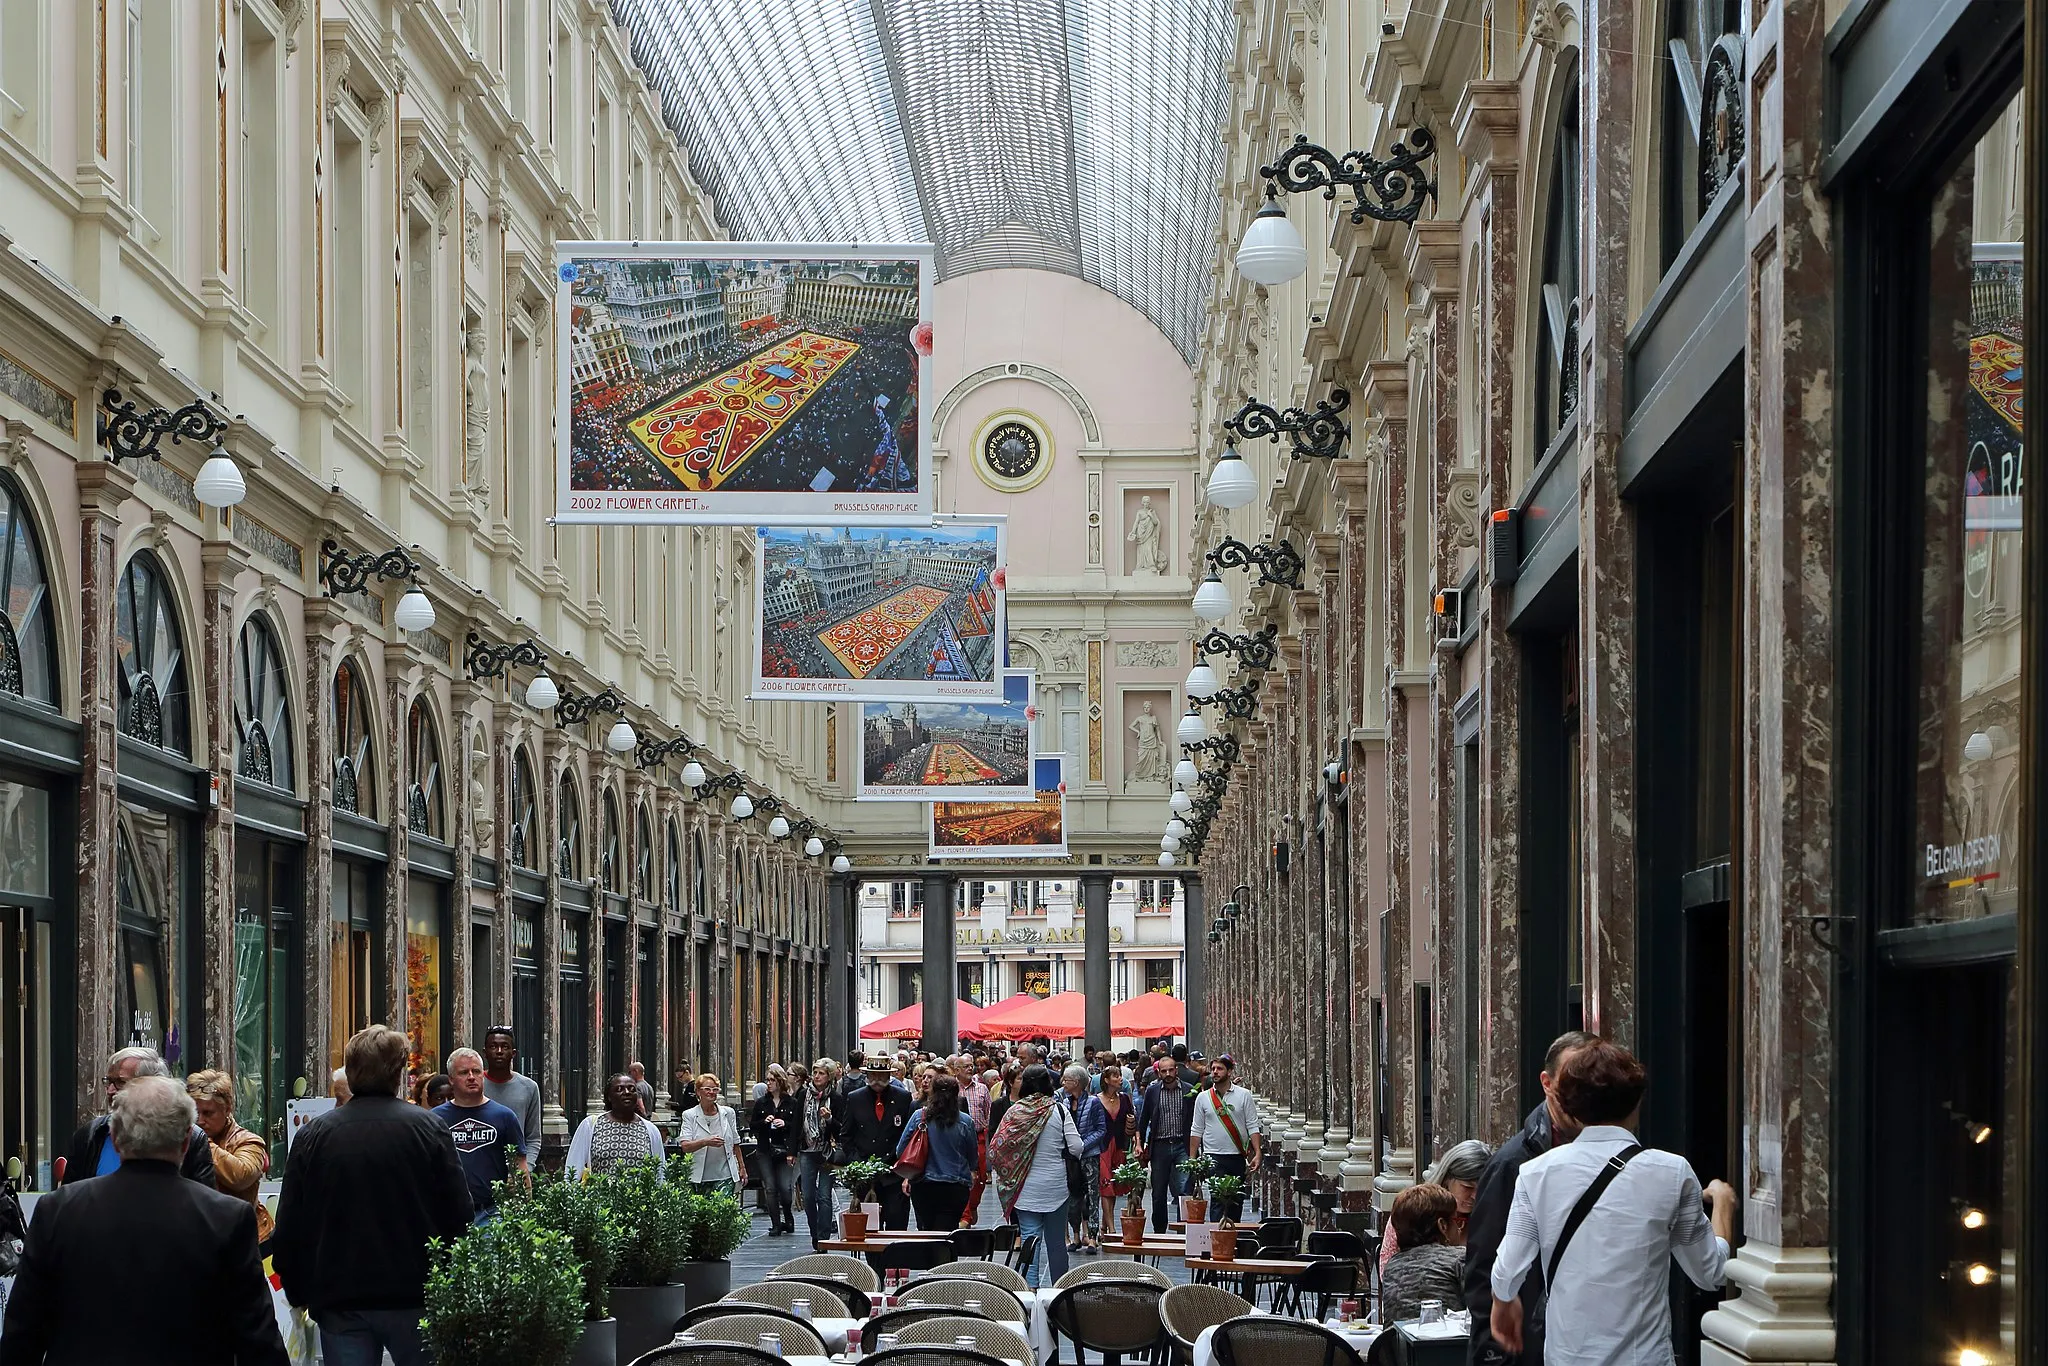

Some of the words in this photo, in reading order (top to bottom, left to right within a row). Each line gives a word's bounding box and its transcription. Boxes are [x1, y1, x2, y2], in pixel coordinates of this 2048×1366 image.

[570, 497, 602, 510] 2002
[606, 497, 652, 510] FLOWER
[834, 503, 870, 512] BRUSSELS
[896, 503, 918, 512] PLACE
[761, 681, 783, 691] 2006
[785, 682, 816, 691] FLOWER
[955, 928, 1001, 945] ELLA
[1045, 926, 1122, 944] ARTS
[882, 1029, 917, 1038] BRUSSELS
